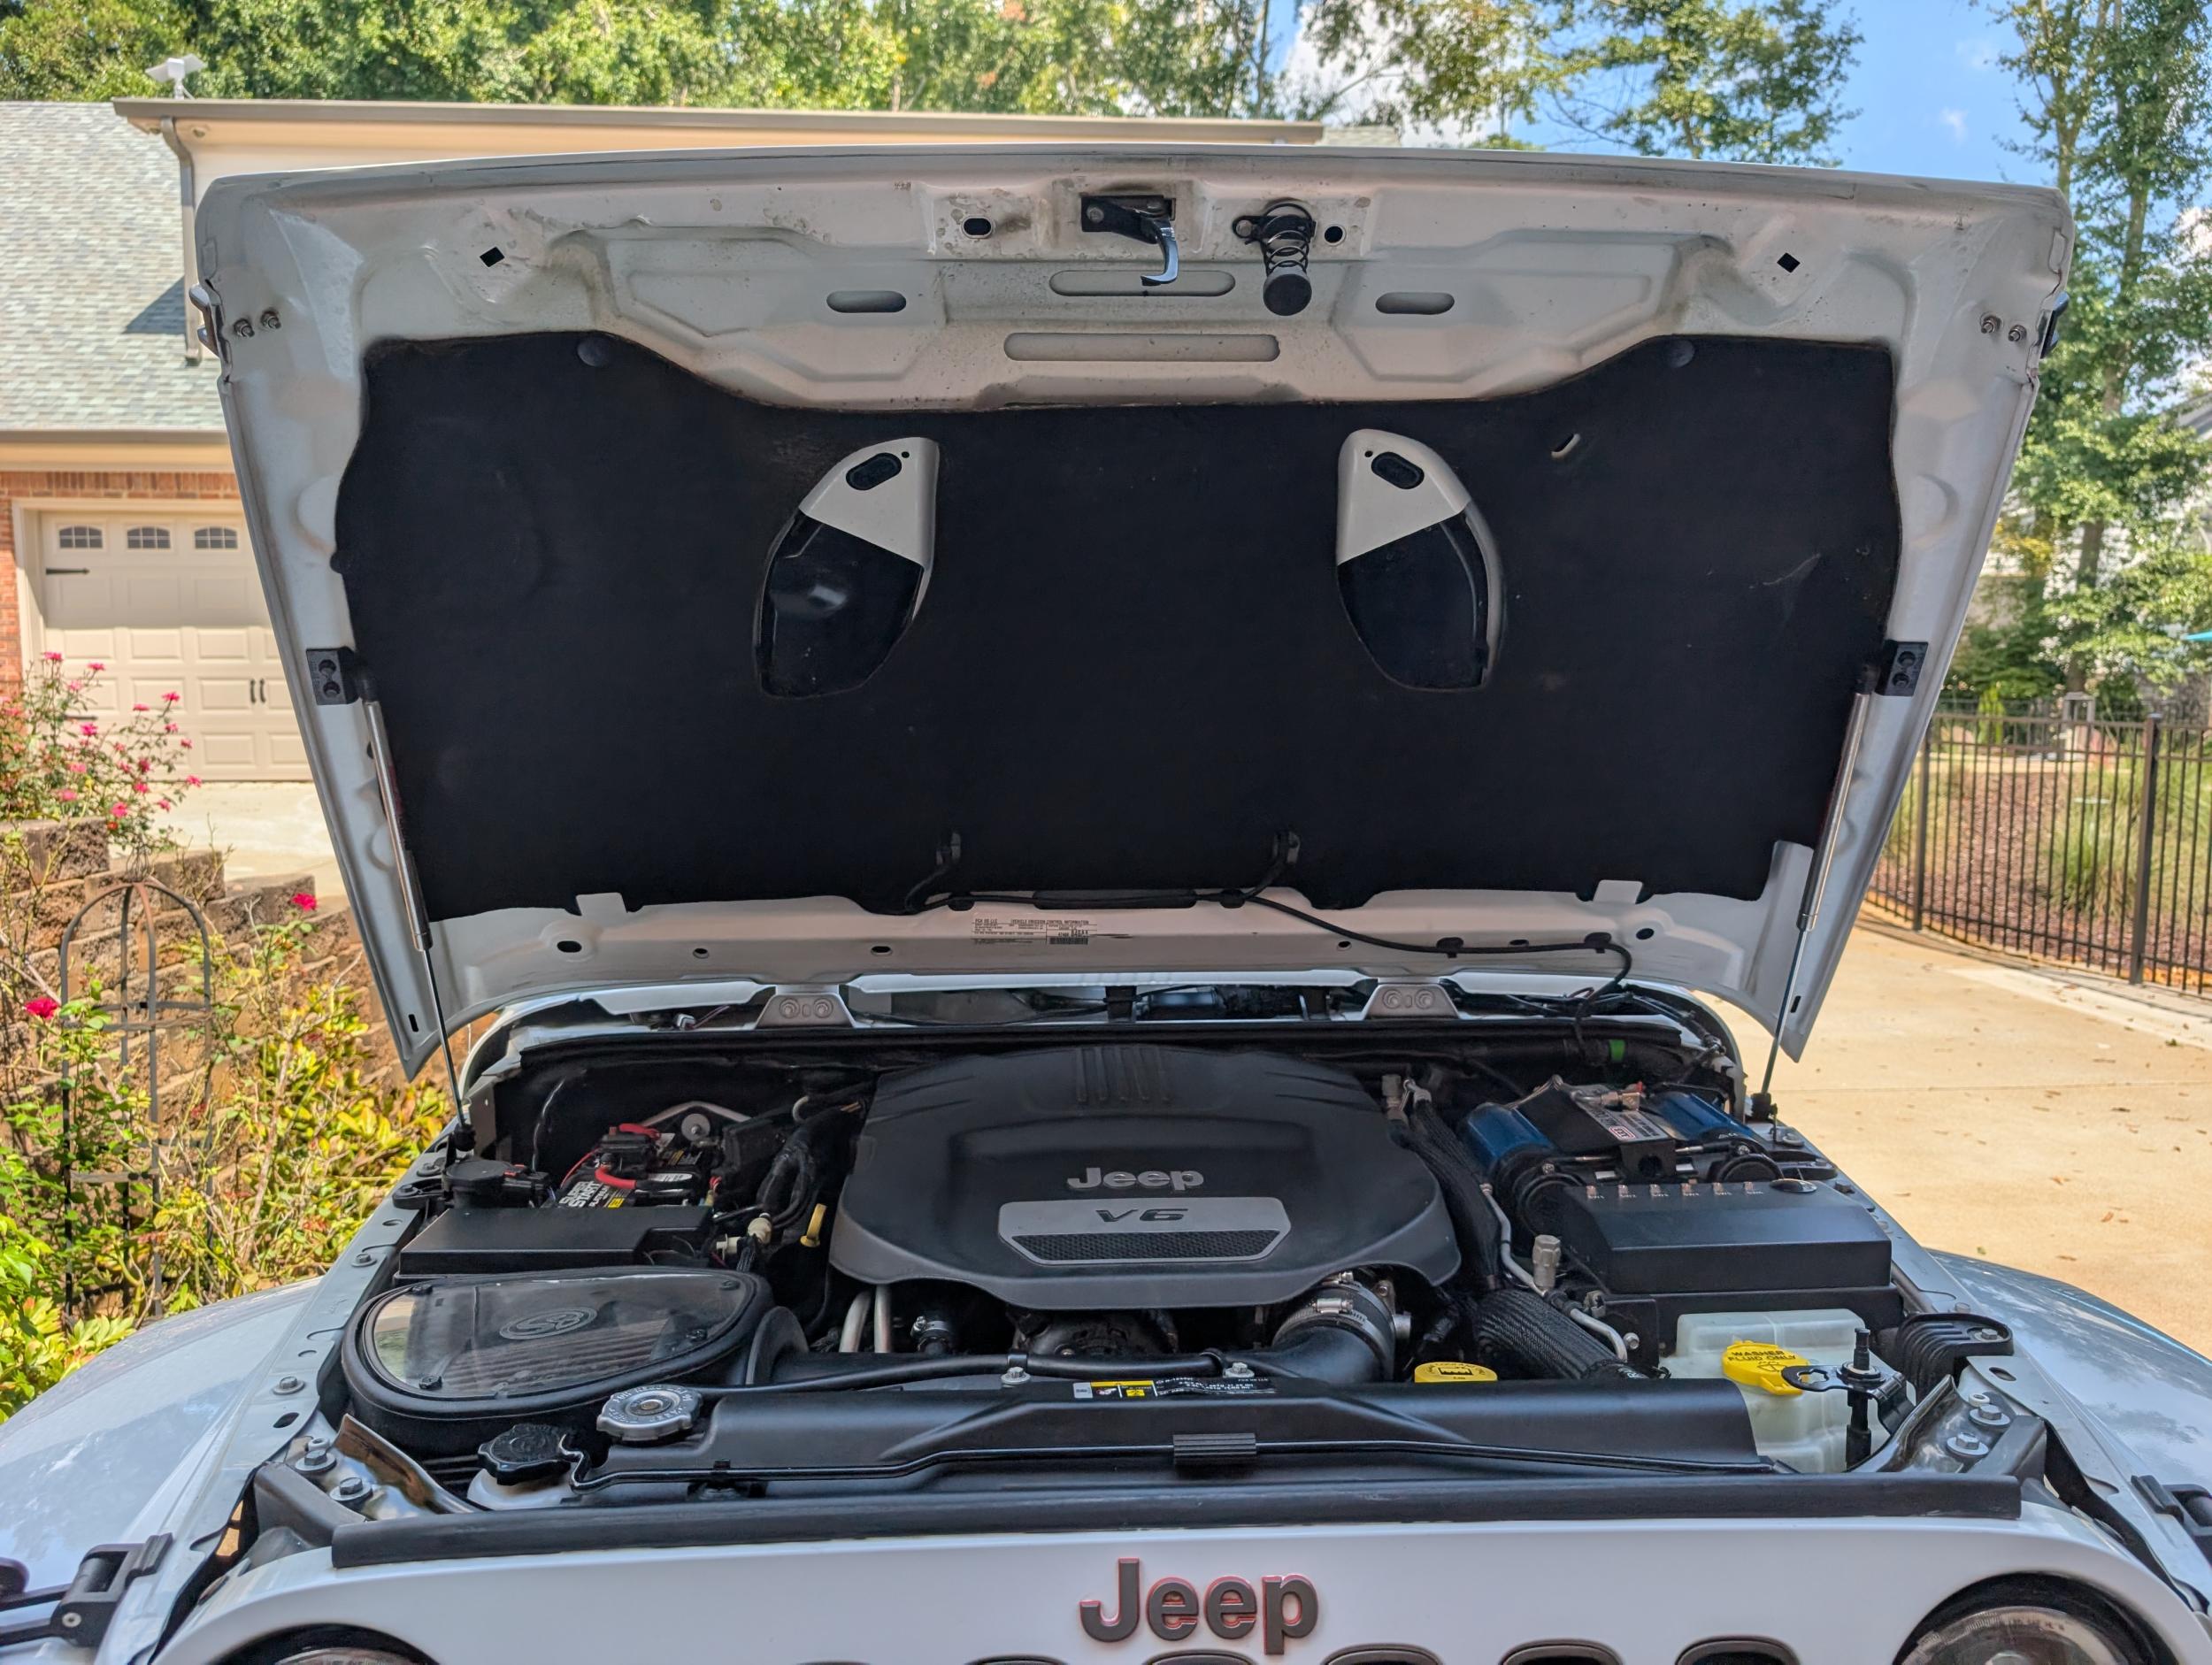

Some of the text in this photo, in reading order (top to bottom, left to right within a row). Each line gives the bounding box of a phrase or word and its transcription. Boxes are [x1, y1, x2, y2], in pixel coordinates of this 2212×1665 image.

[1067, 1167, 1204, 1192] Jeep
[568, 1181, 602, 1208] START
[1094, 1208, 1189, 1224] V6
[1079, 1557, 1319, 1655] Jeep
